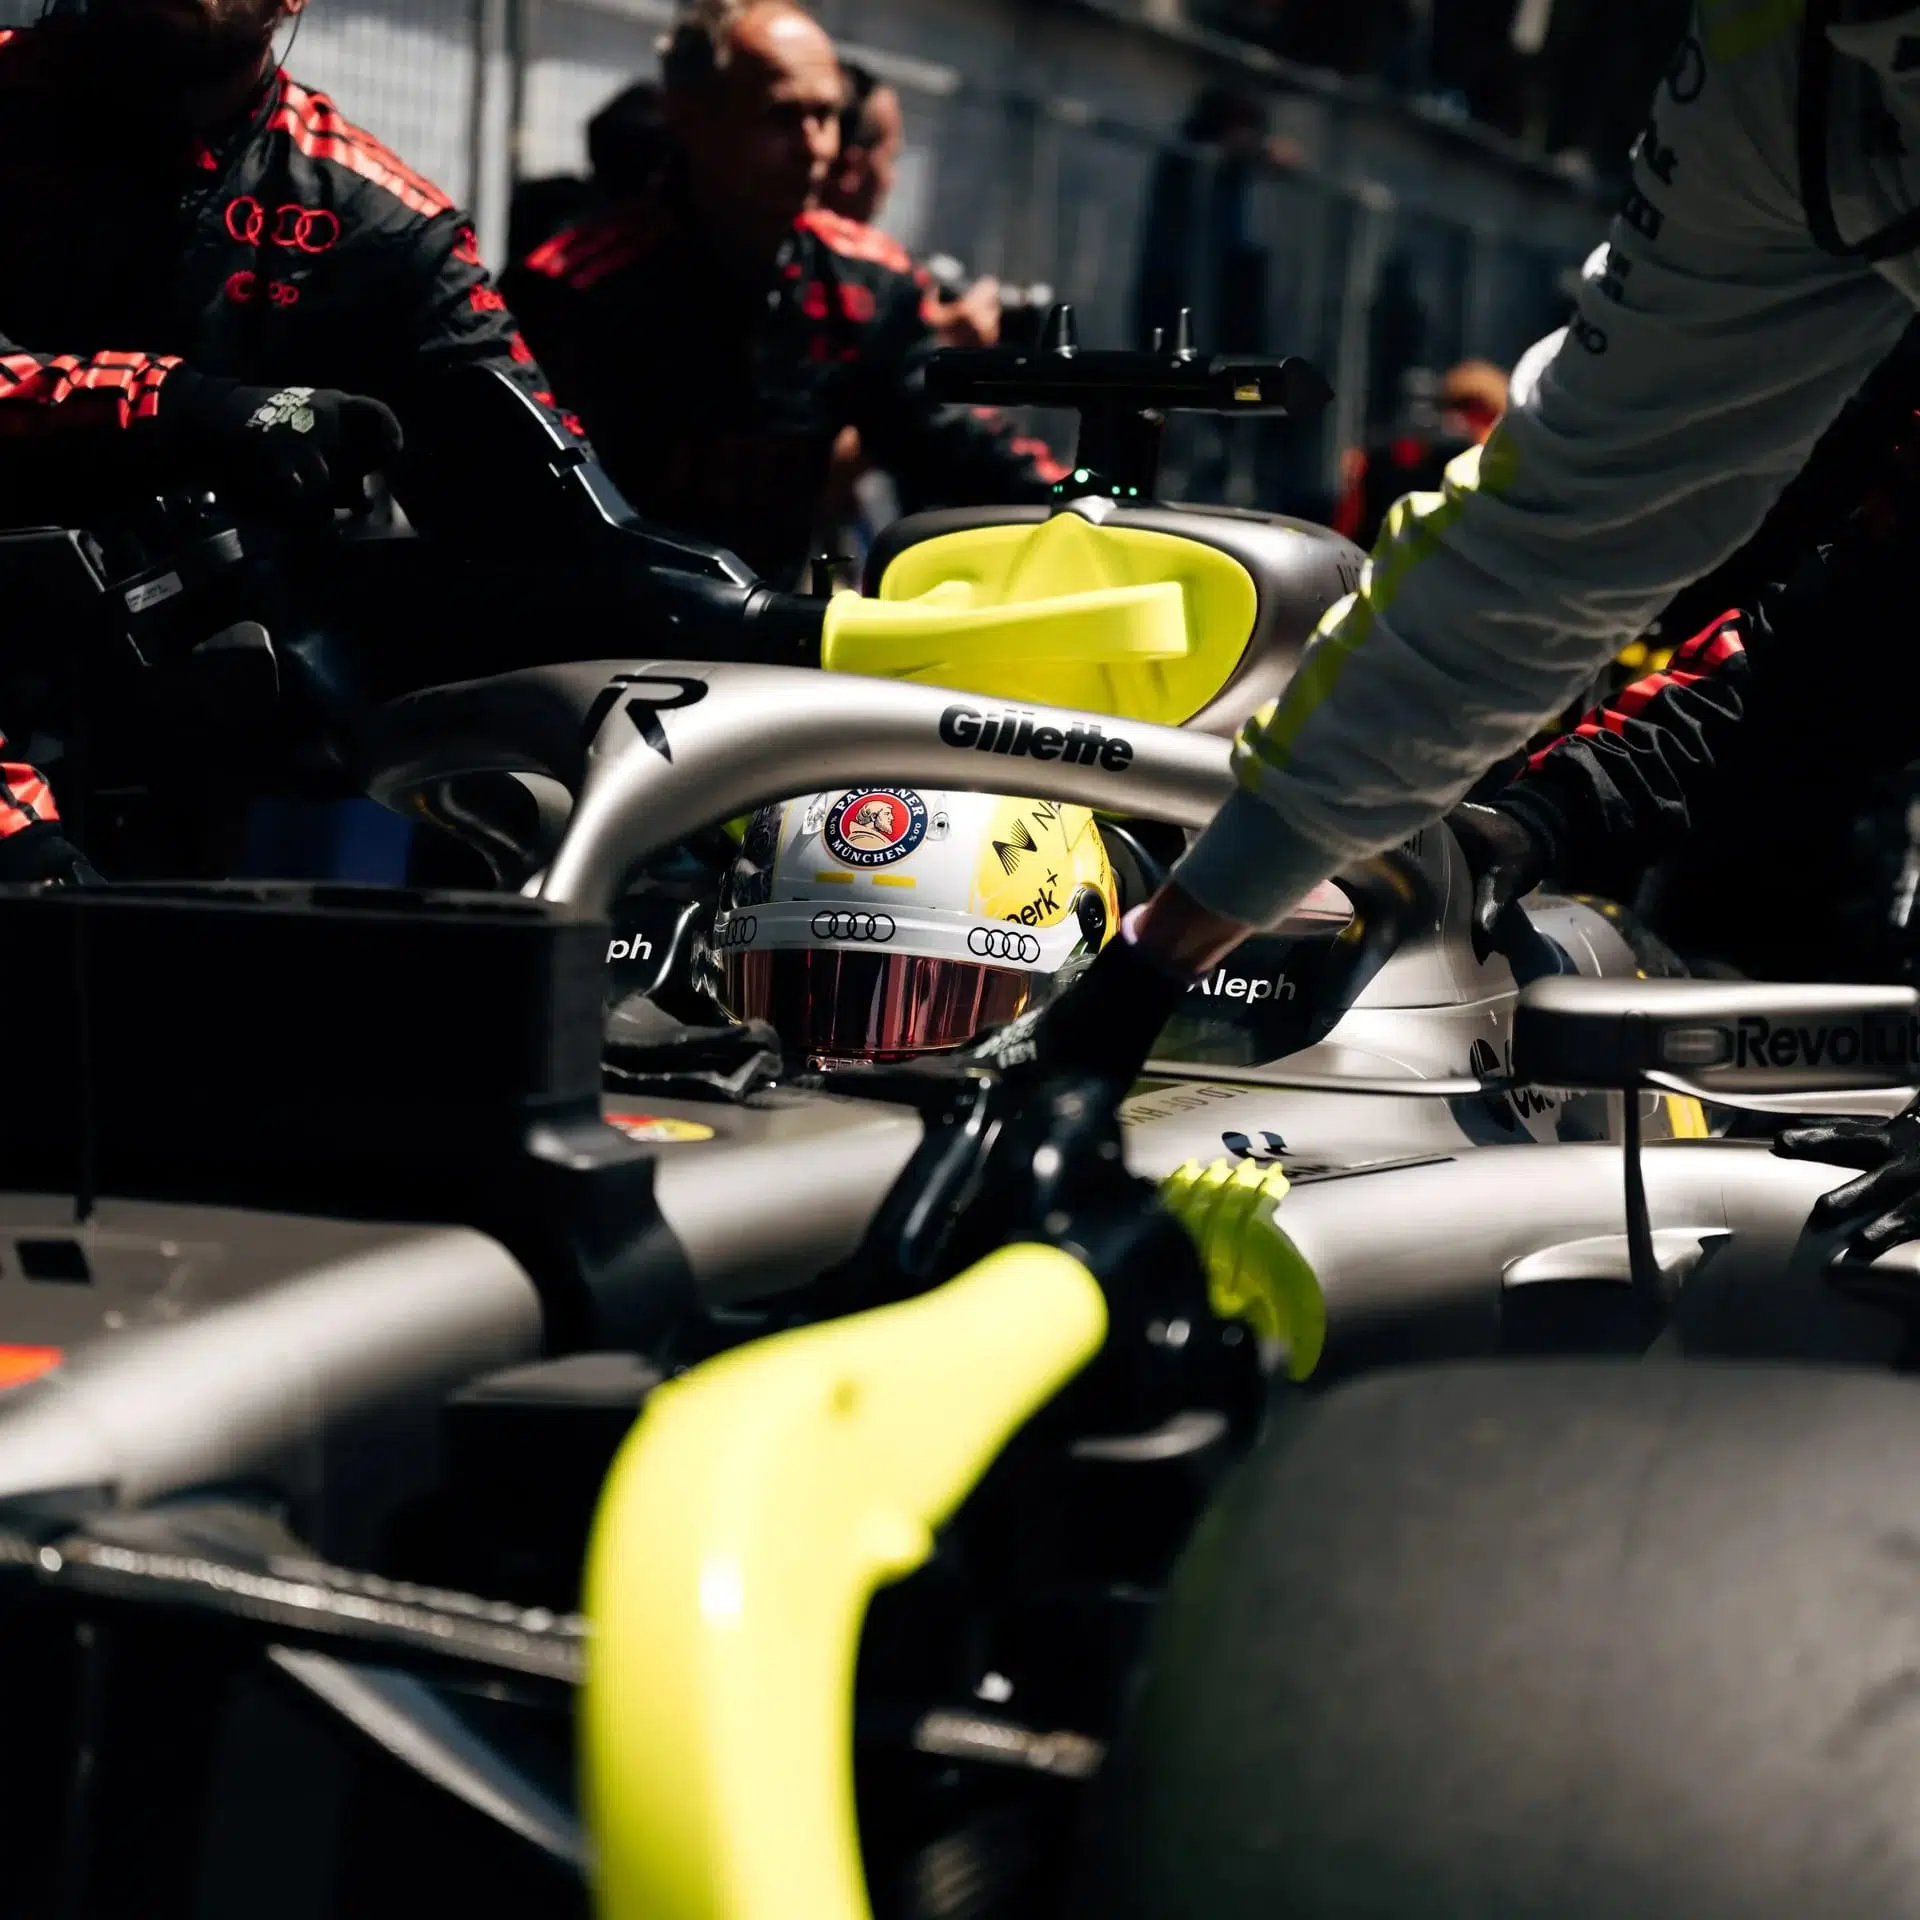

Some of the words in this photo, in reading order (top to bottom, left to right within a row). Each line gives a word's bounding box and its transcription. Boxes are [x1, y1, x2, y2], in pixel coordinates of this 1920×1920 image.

[580, 674, 709, 765] R
[939, 704, 1134, 772] Gillette
[836, 787, 925, 816] PAUNER
[832, 839, 907, 863] MÜNCHEN
[605, 933, 653, 963] ph
